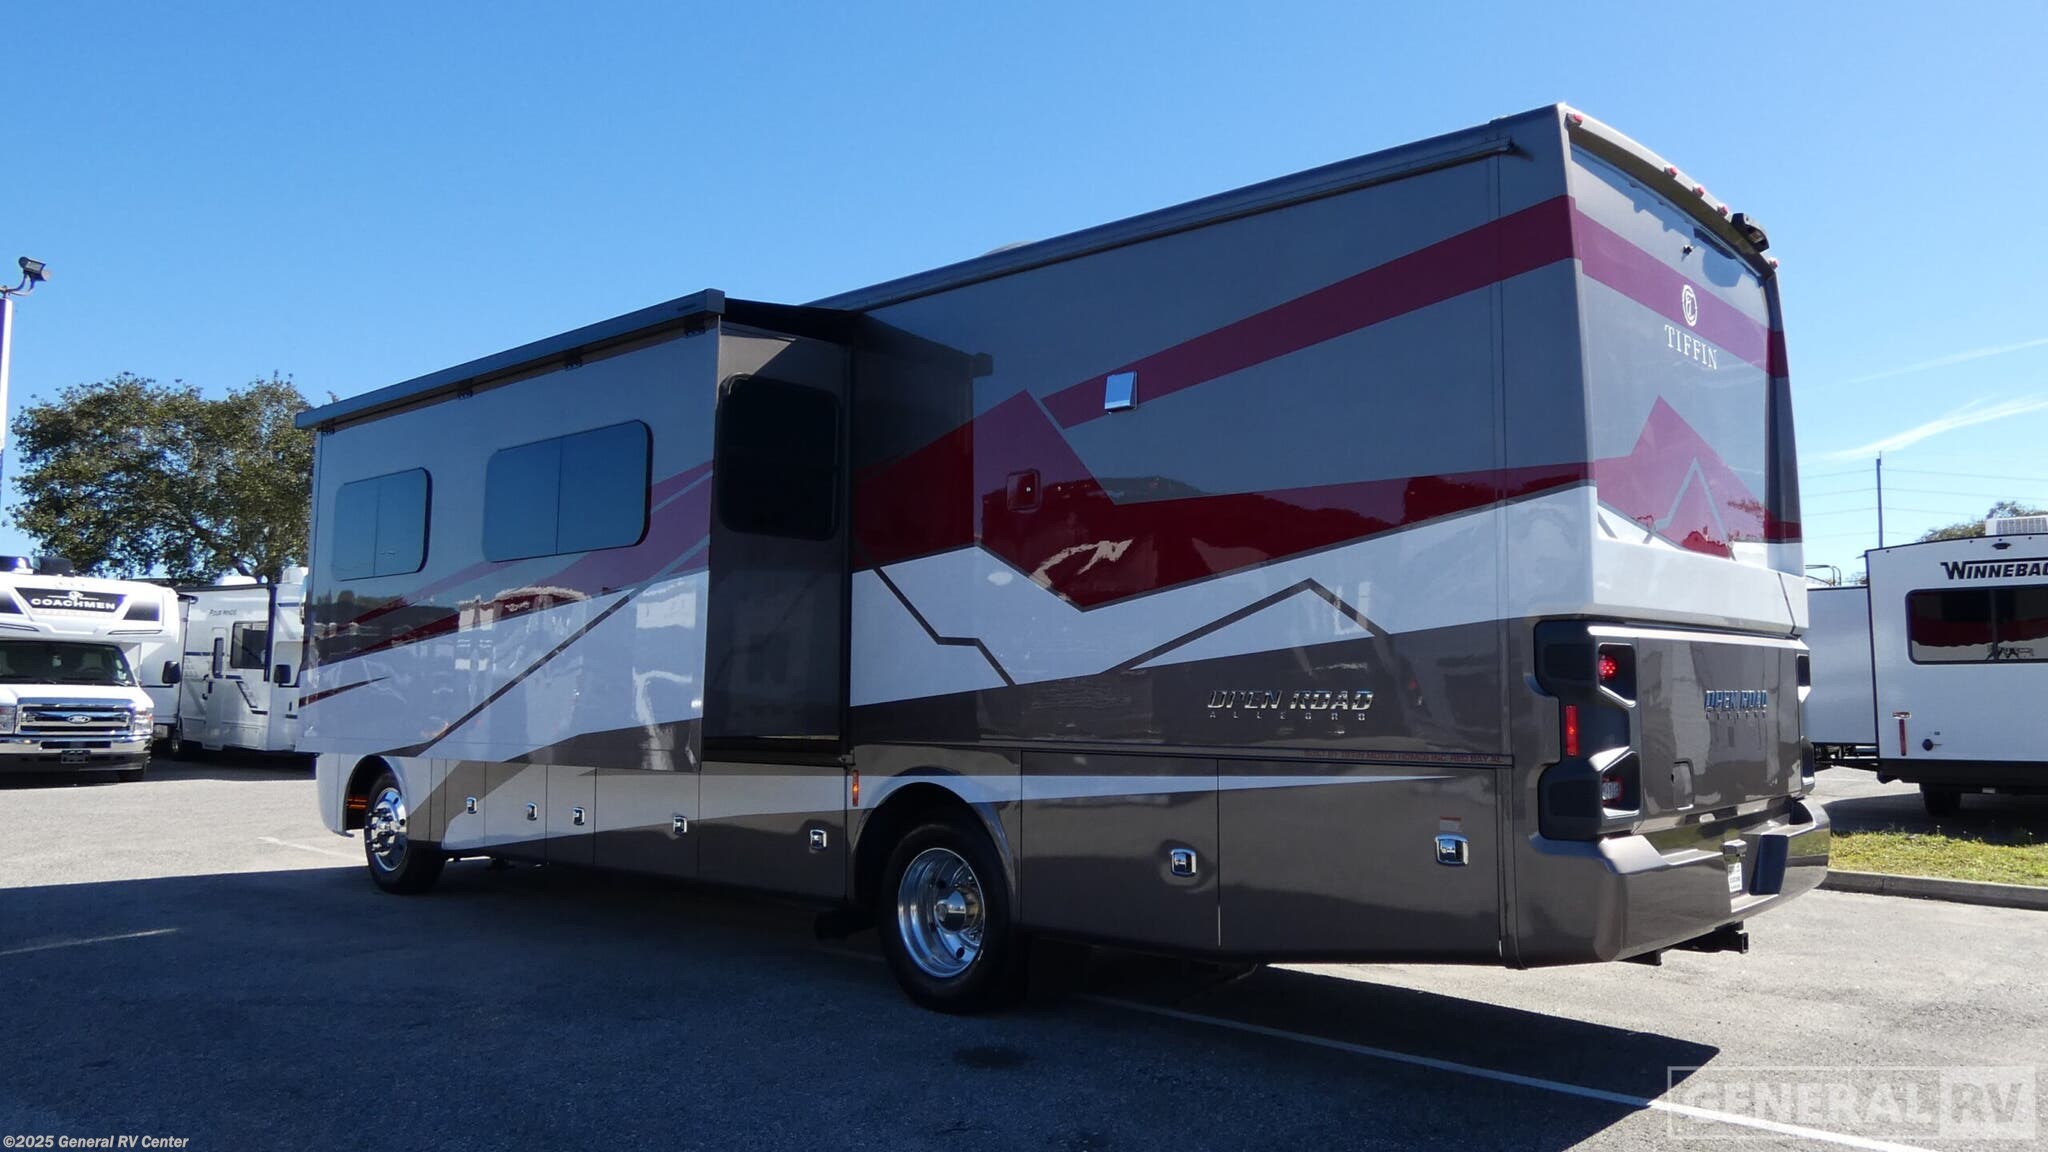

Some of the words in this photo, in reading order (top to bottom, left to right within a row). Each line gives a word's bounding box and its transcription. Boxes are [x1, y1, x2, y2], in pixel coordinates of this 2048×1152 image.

[1664, 324, 1718, 370] TIFFIN
[31, 598, 116, 610] COACHMEN
[1207, 690, 1283, 709] OPEN
[1290, 690, 1374, 710] ROAD
[1209, 711, 1367, 721] ALLEGRO
